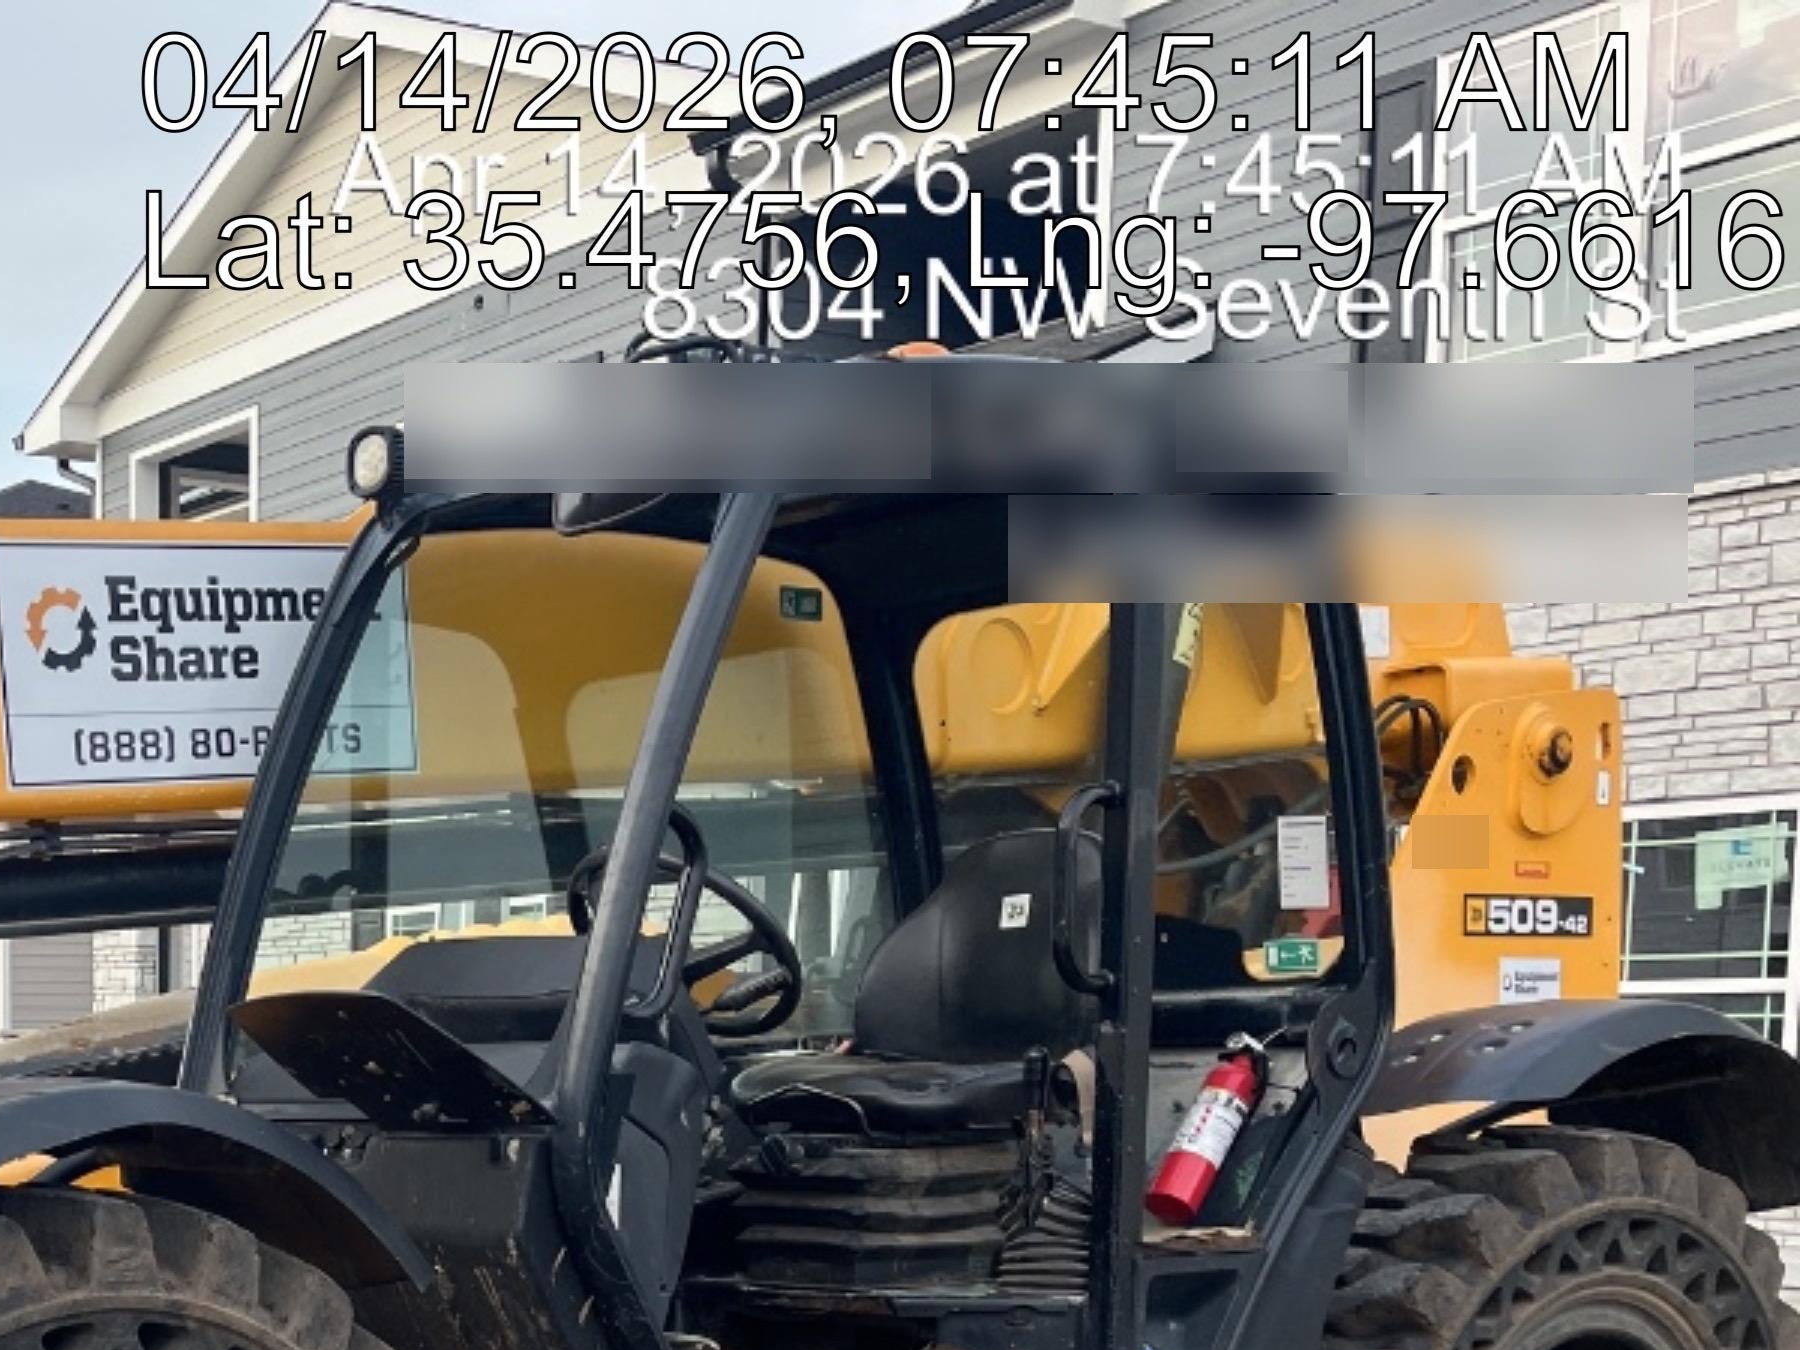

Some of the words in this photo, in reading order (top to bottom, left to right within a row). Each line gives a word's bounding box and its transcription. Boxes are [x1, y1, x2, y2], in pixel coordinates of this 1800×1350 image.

[105, 575, 382, 633] Equipme
[110, 636, 260, 681] Share
[73, 726, 176, 765] (888)
[190, 723, 363, 758] 80-RTS
